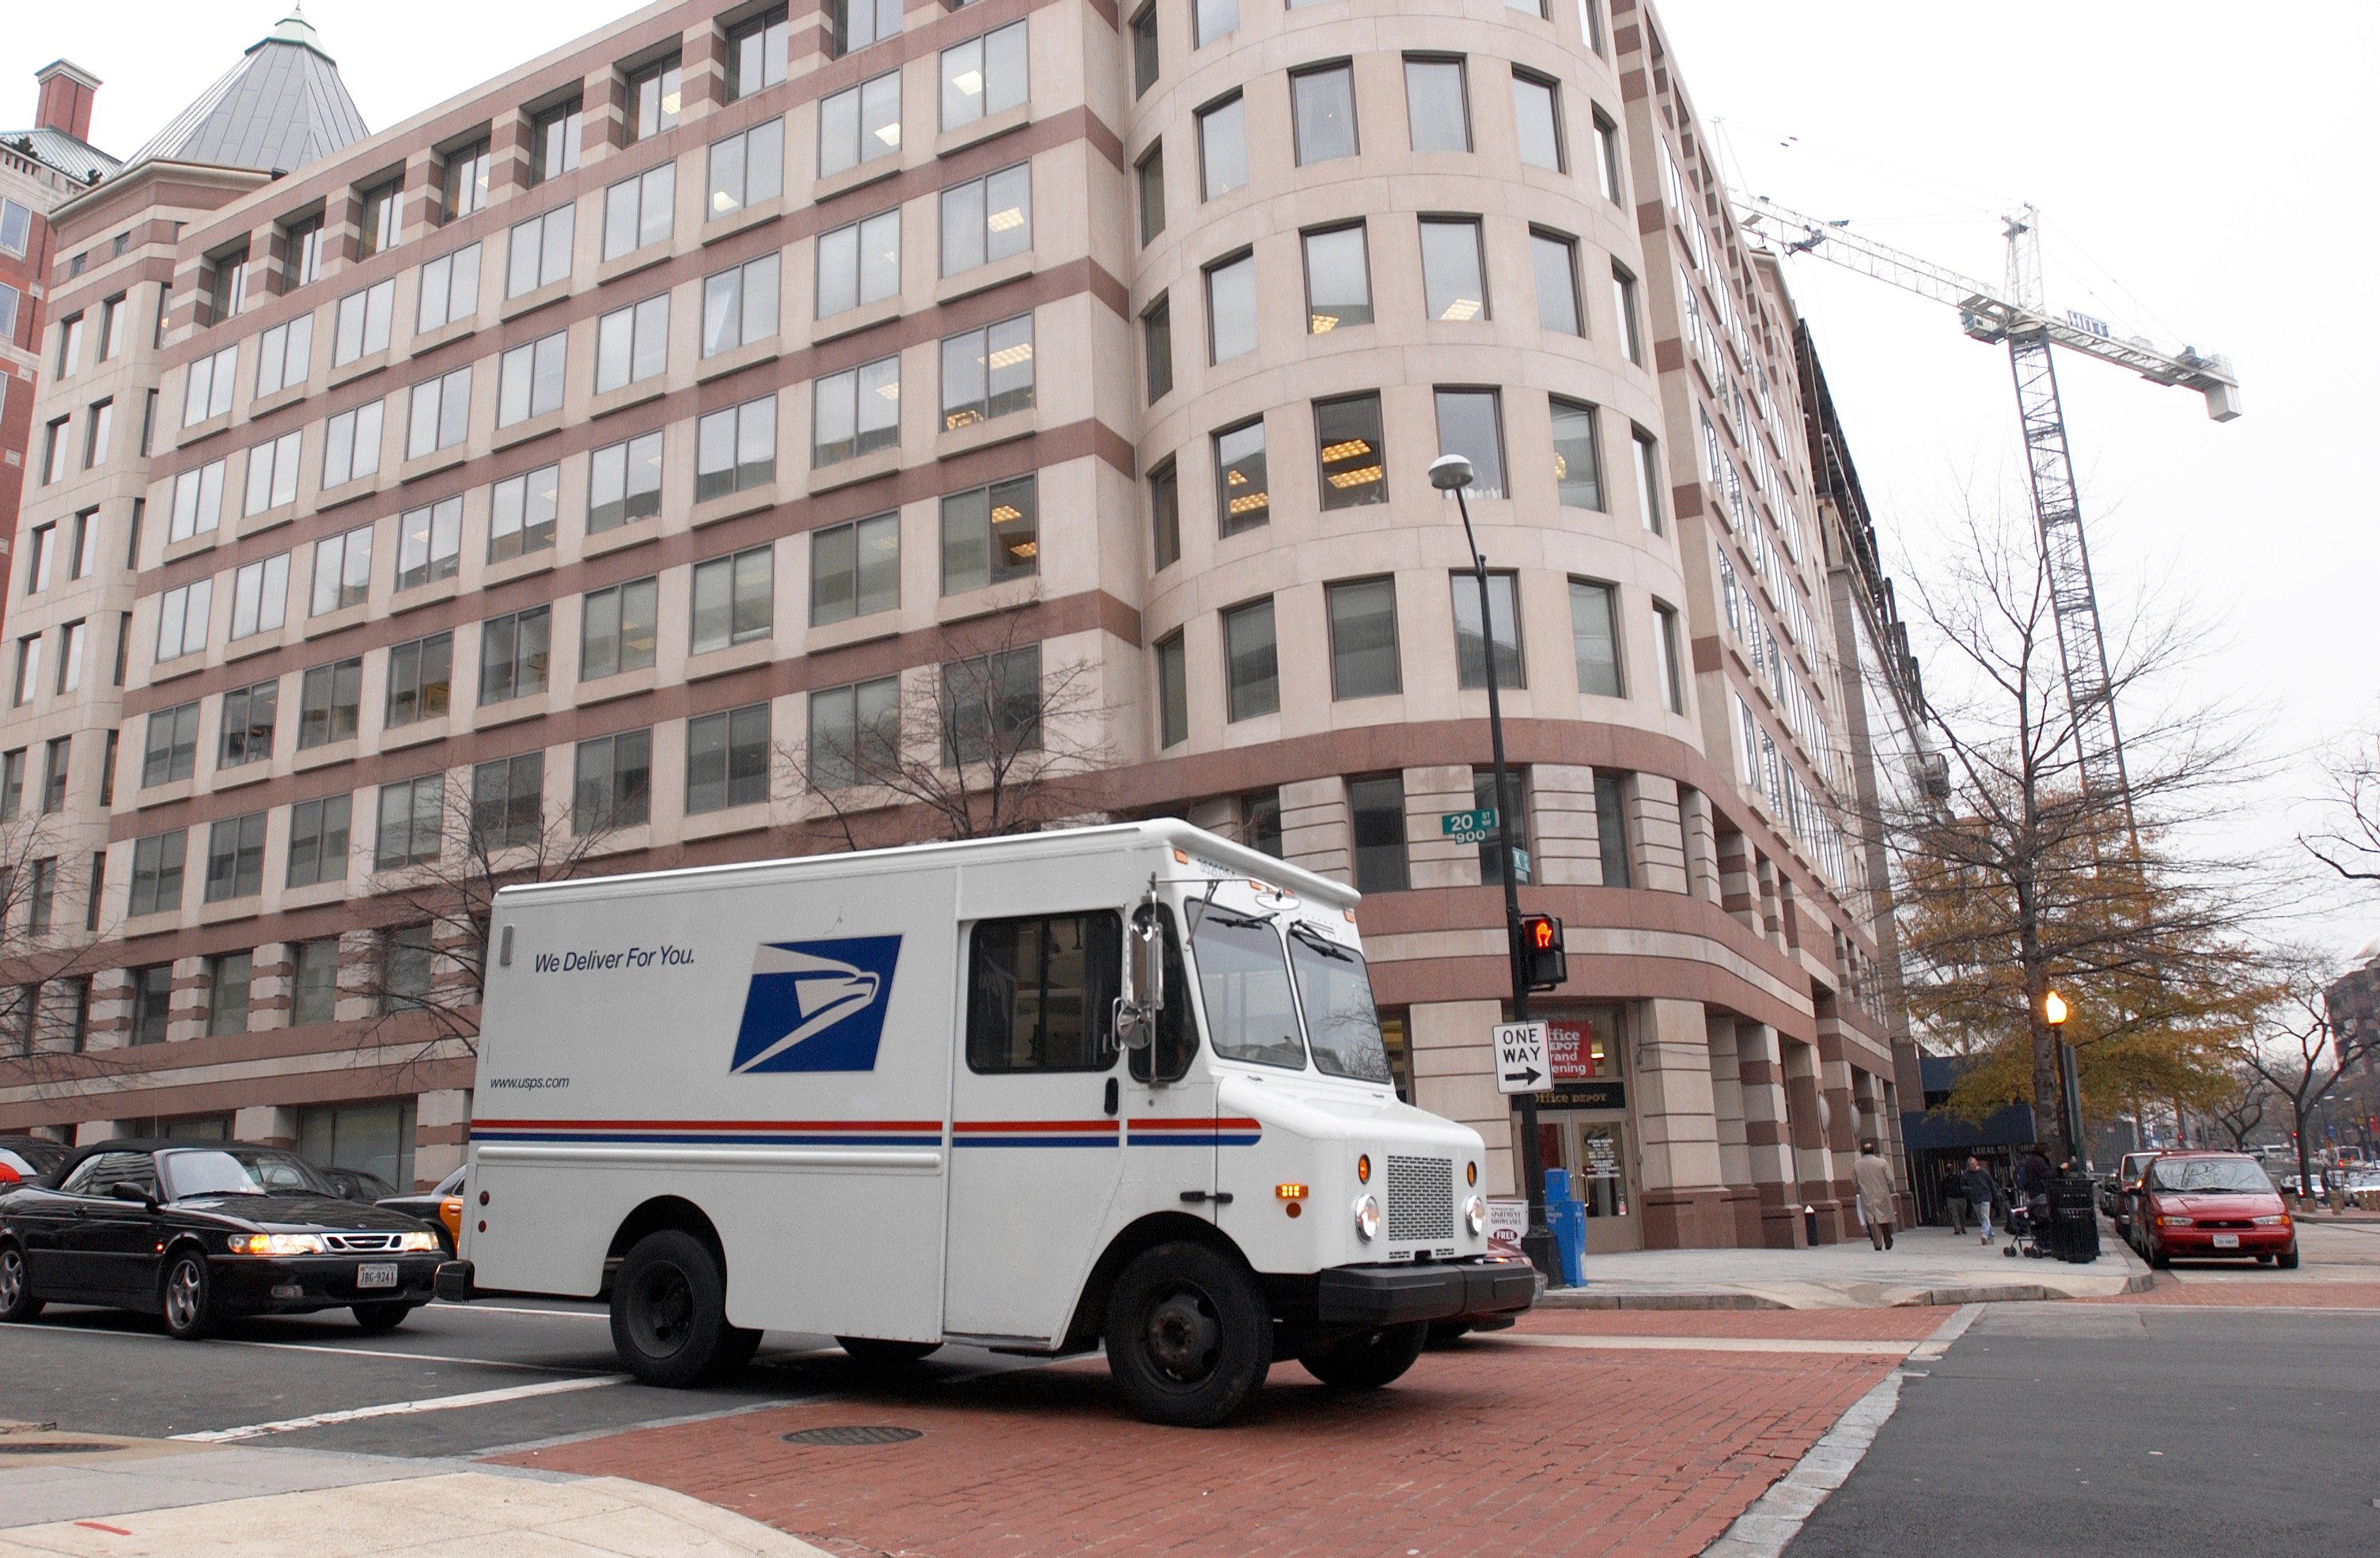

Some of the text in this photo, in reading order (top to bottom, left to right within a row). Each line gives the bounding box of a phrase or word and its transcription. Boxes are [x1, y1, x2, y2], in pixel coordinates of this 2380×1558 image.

[1450, 814, 1473, 831] 20
[1456, 830, 1486, 843] 900
[1515, 852, 1522, 866] K
[535, 945, 695, 973] We Deliver For You.
[1503, 1028, 1539, 1044] ONE
[1503, 1046, 1541, 1063] WAY
[1551, 1051, 1578, 1062] rand
[1552, 1063, 1586, 1075] ening
[490, 1077, 570, 1091] www.usps.com
[1496, 1230, 1515, 1240] FREE
